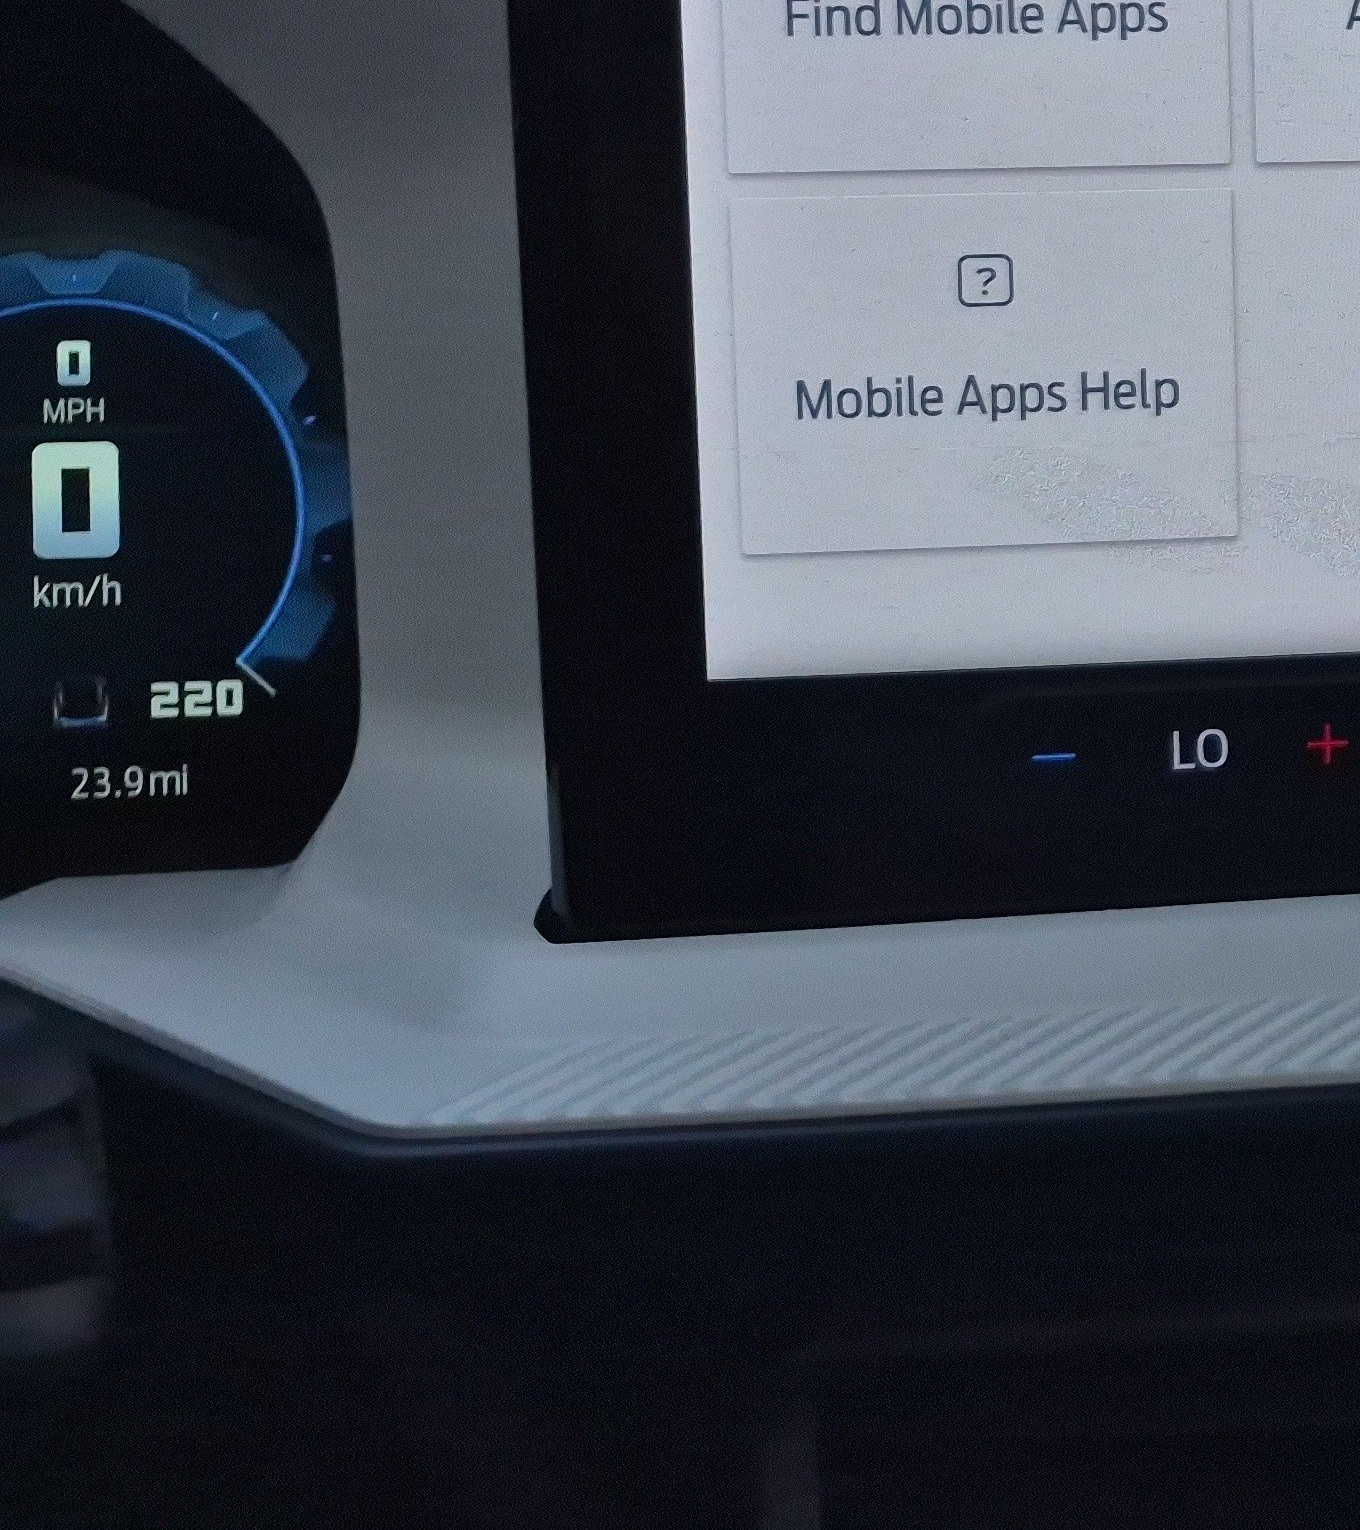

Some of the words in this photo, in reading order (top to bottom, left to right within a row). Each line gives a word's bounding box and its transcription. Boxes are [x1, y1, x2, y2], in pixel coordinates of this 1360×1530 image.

[56, 340, 91, 386] 0
[43, 398, 105, 423] MPH
[796, 377, 943, 419] Mobile
[957, 374, 1067, 421] Apps
[1080, 368, 1181, 416] Help
[31, 441, 120, 559] 0
[33, 574, 122, 609] km/h
[150, 679, 244, 718] 220
[1171, 728, 1230, 770] LO
